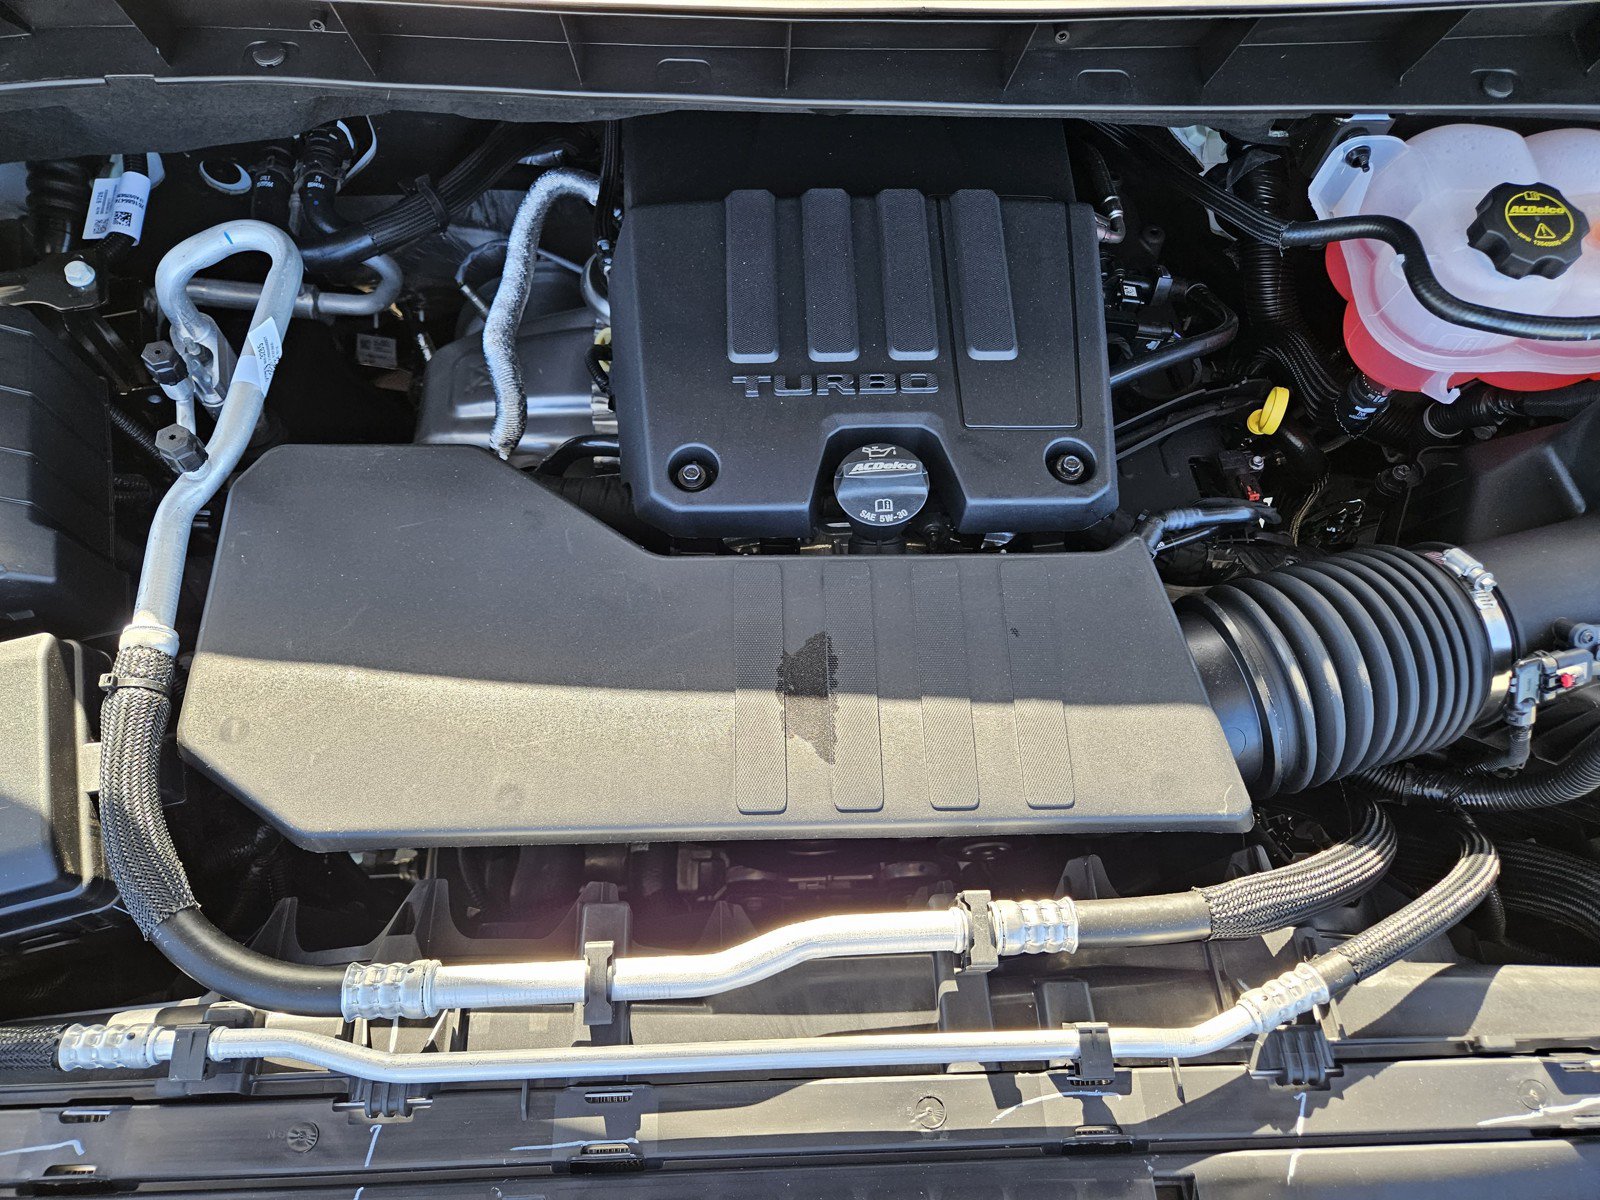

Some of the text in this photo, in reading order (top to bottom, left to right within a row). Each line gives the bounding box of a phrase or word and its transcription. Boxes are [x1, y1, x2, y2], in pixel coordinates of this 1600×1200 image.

[1508, 205, 1566, 215] ACDelco
[731, 373, 939, 398] TURBO
[850, 461, 917, 474] ACDelco
[859, 508, 909, 523] SAE 5W-30
